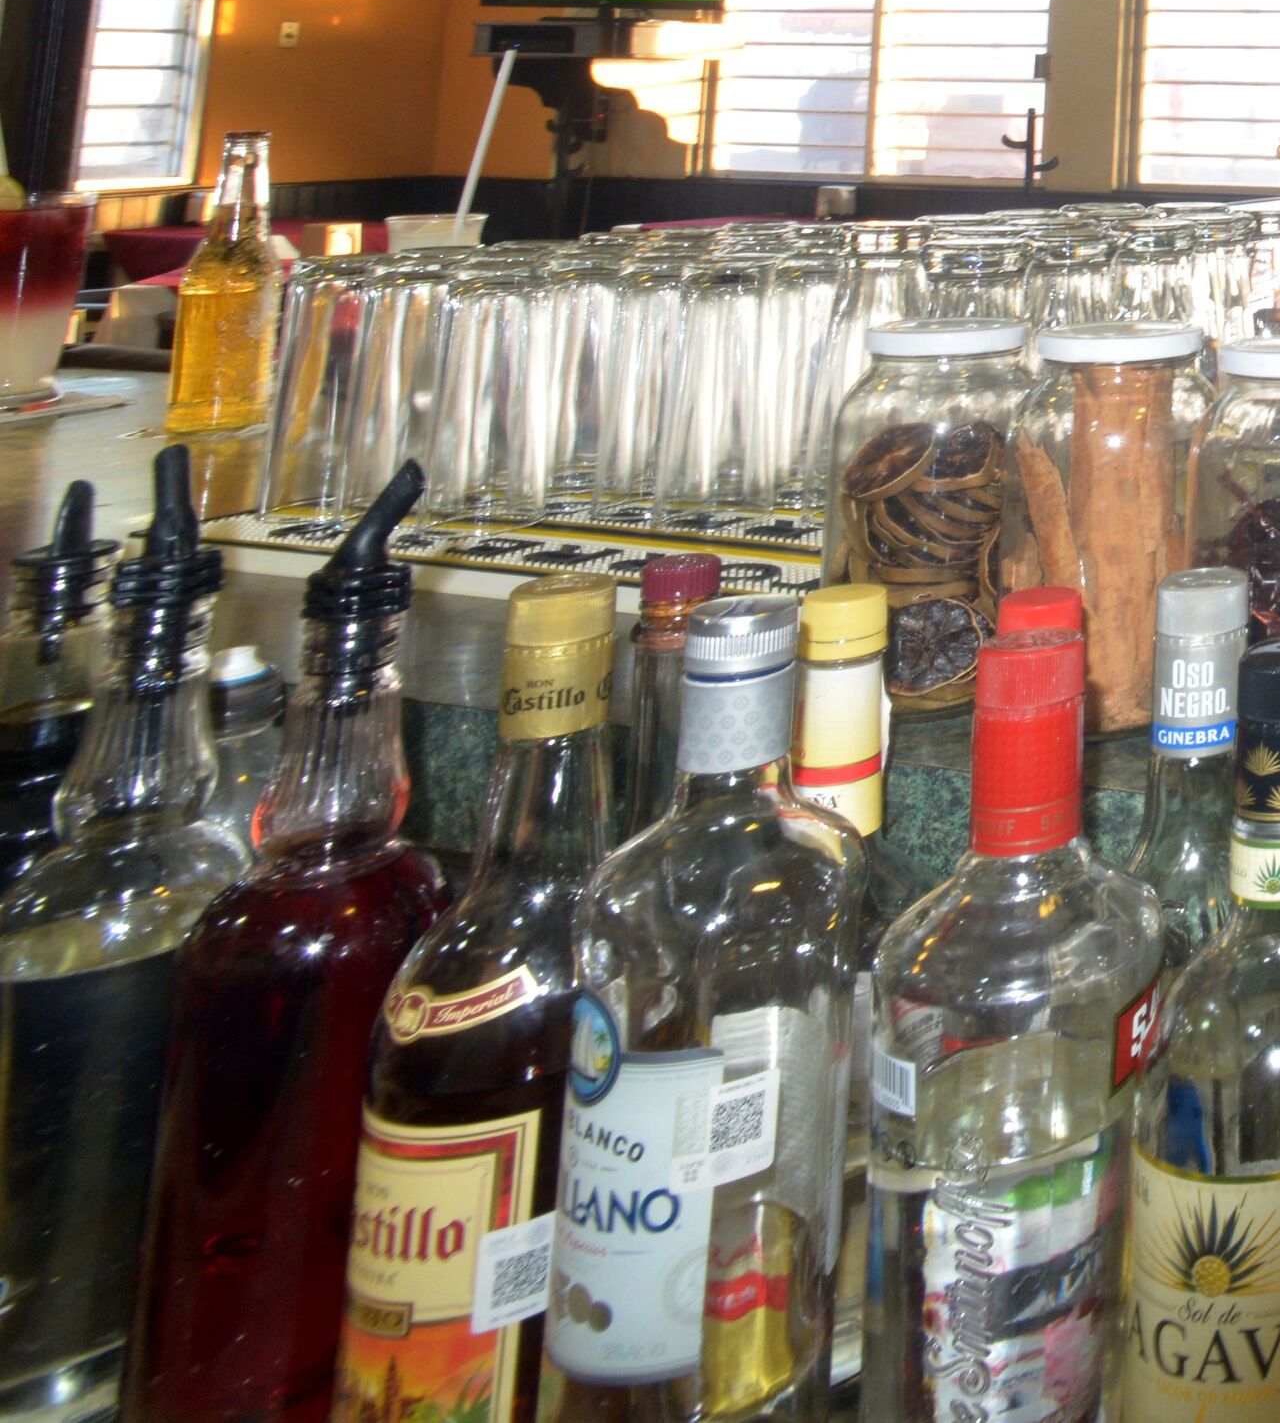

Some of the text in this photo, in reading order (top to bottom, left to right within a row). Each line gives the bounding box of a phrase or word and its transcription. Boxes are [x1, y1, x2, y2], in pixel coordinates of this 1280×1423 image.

[526, 679, 554, 689] RON
[1172, 659, 1214, 689] OSO
[502, 687, 586, 715] Castillo
[1160, 687, 1227, 718] NEGRO
[1158, 725, 1230, 745] GINEBRA
[433, 981, 521, 1024] Imperial
[568, 1109, 645, 1163] BLANCO
[563, 1171, 681, 1234] LLANO
[355, 1205, 466, 1264] stillo
[1177, 1296, 1242, 1326] Sol de
